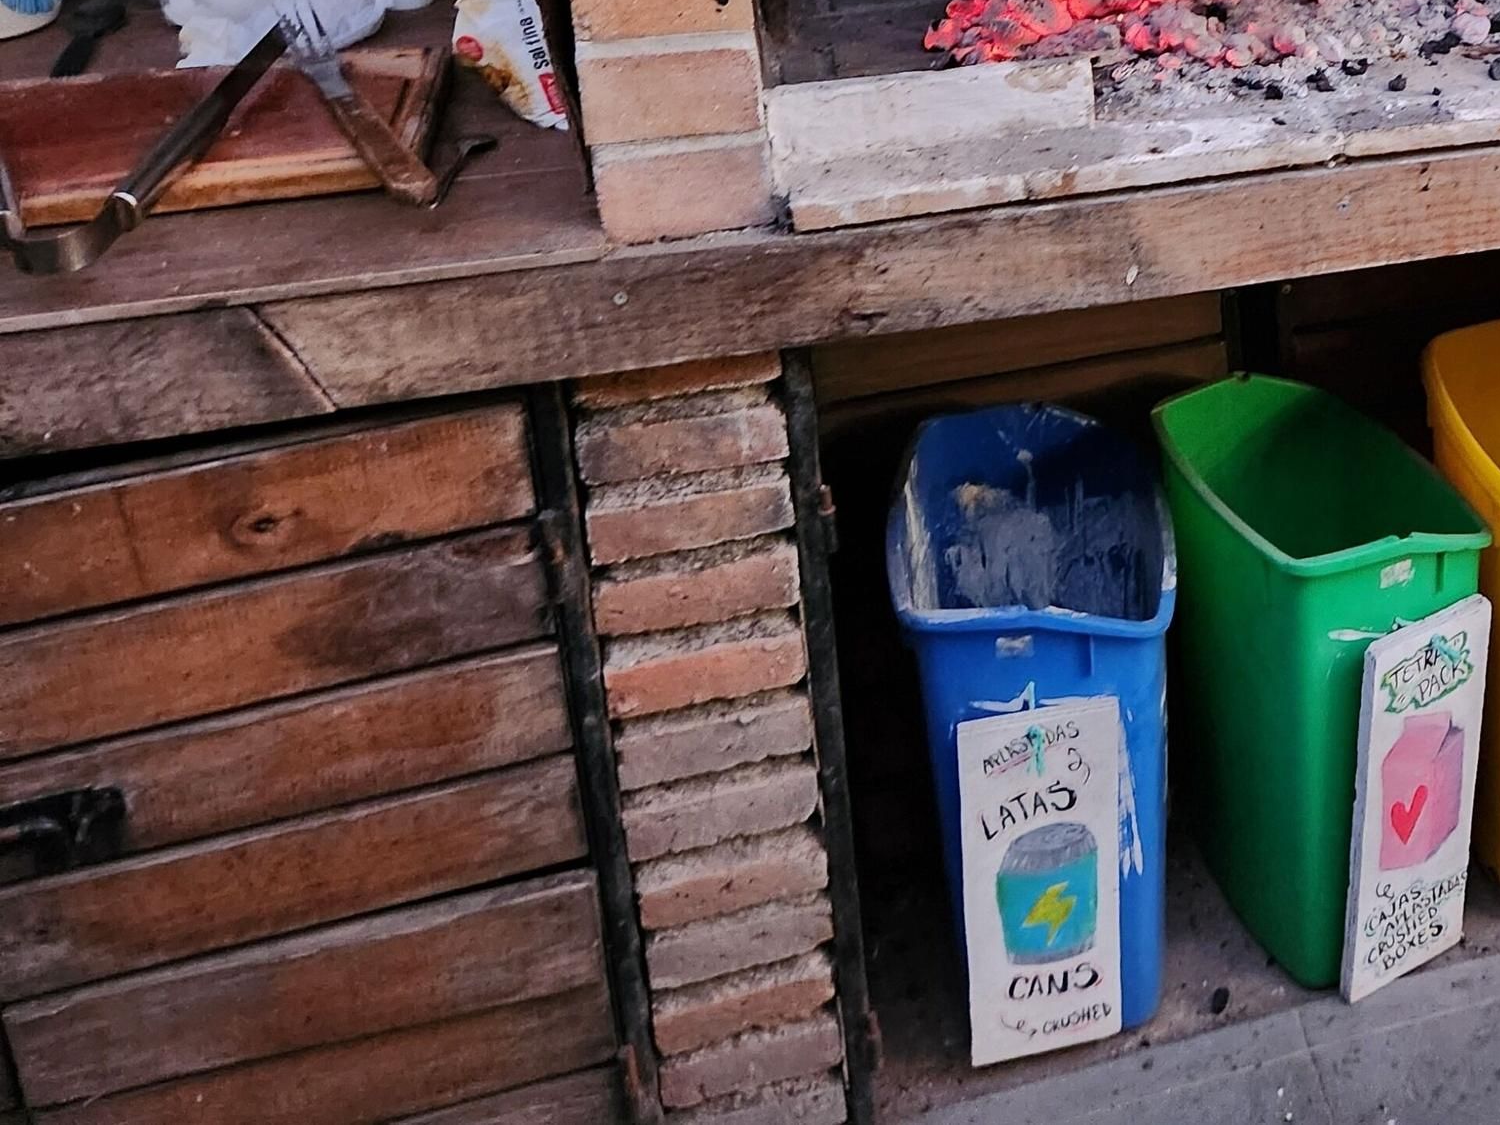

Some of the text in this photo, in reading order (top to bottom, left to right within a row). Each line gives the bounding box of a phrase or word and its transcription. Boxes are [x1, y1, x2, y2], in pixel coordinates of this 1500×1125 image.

[520, 17, 540, 45] fina
[529, 47, 549, 70] Sal
[1417, 660, 1465, 701] PACK
[981, 779, 1078, 841] LATAS
[1369, 889, 1421, 931] CAJAS
[1368, 907, 1438, 963] CRUSHED
[1382, 919, 1443, 970] BOXES
[1008, 962, 1099, 1000] CANS
